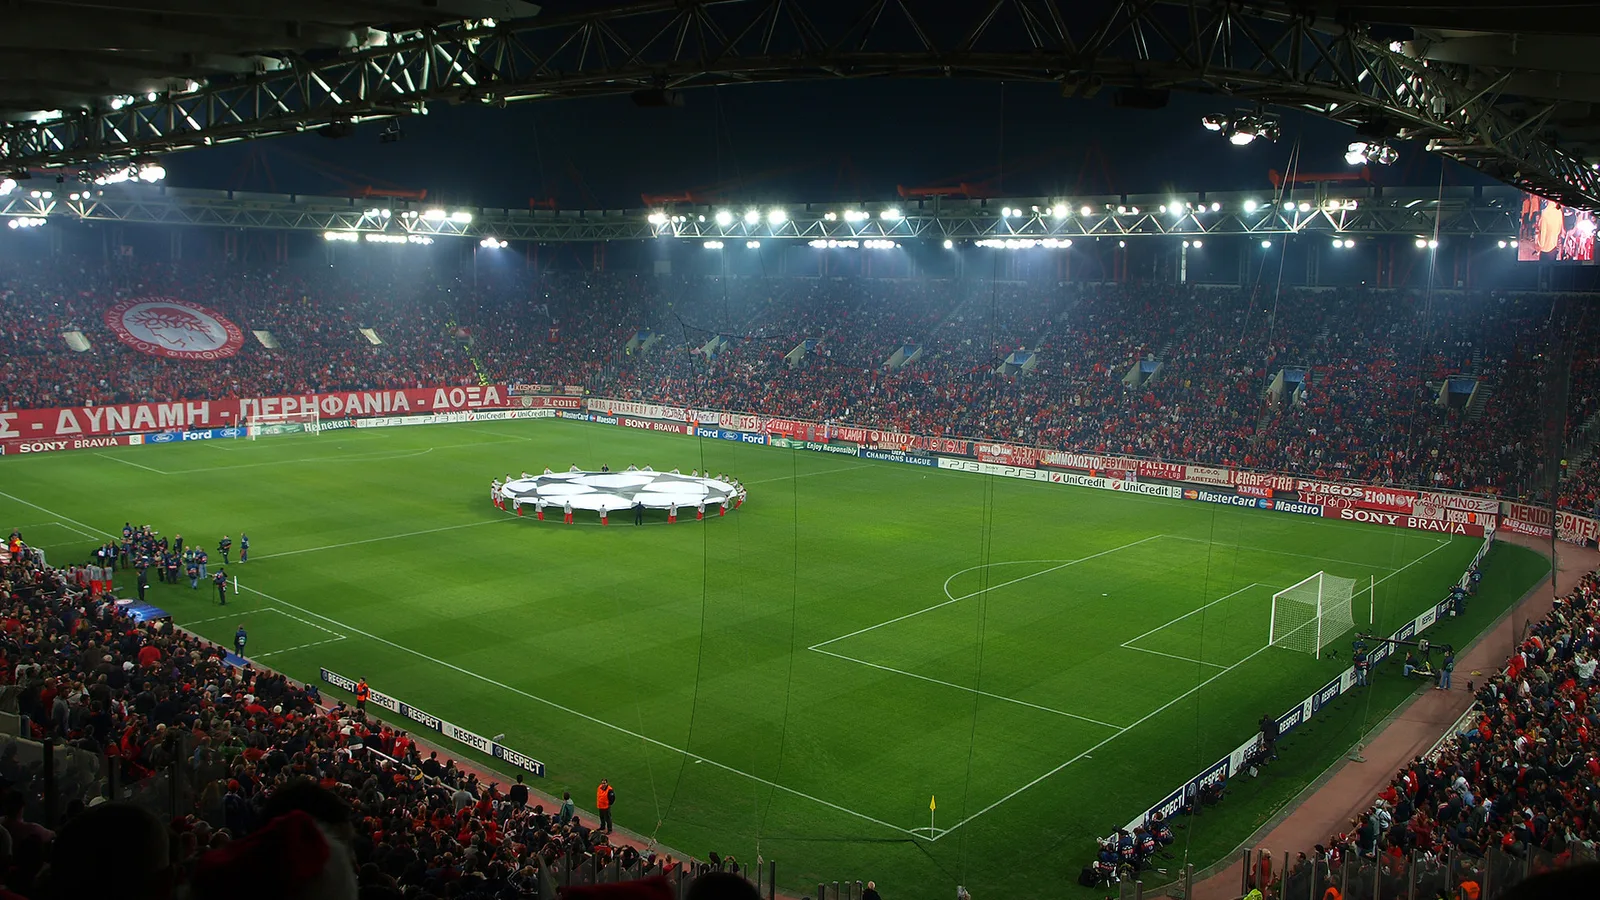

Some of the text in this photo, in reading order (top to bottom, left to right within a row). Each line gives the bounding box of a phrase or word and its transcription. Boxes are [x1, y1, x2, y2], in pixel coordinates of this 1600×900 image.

[543, 397, 577, 407] Leone
[55, 402, 209, 435] ΔΥΝΑΜΗ
[240, 391, 410, 420] ΠΕΡΗΦΑΝΙΑ
[433, 386, 500, 409] ΔΟΞΑ
[475, 411, 506, 420] UniCredit
[518, 409, 547, 419] UniCredit
[304, 420, 349, 432] Heneken
[625, 419, 680, 433] SONY BRAVIA
[698, 428, 718, 438] Ford
[182, 430, 212, 441] Ford
[742, 434, 764, 444] Ford
[881, 431, 915, 446] KIATO 7
[20, 437, 118, 453] SONY BRAVIA
[807, 442, 822, 451] Enjoy
[823, 443, 857, 456] Responsibly
[866, 451, 932, 466] CHAMPIONS LEAGUE
[950, 460, 979, 472] PS3
[1101, 457, 1137, 470] ΡΕΘΥΜΝΟ
[1005, 466, 1036, 479] PS3
[1063, 473, 1105, 487] UniCredit
[1123, 482, 1168, 496] UniCredit
[1298, 480, 1363, 498] PYRGOS
[1198, 490, 1256, 507] MasterCard
[1275, 500, 1319, 515] Maestro
[1340, 508, 1466, 535] SONY BRAVIA
[1447, 509, 1496, 529] KEFAONIA
[1563, 514, 1591, 537] GATE
[327, 669, 355, 693] RESPECT
[371, 691, 396, 710] ESPECT
[408, 708, 439, 731] RESPECT
[1279, 710, 1301, 734] RESPECT
[453, 726, 488, 751] RESPECT
[502, 748, 541, 776] RESPECT
